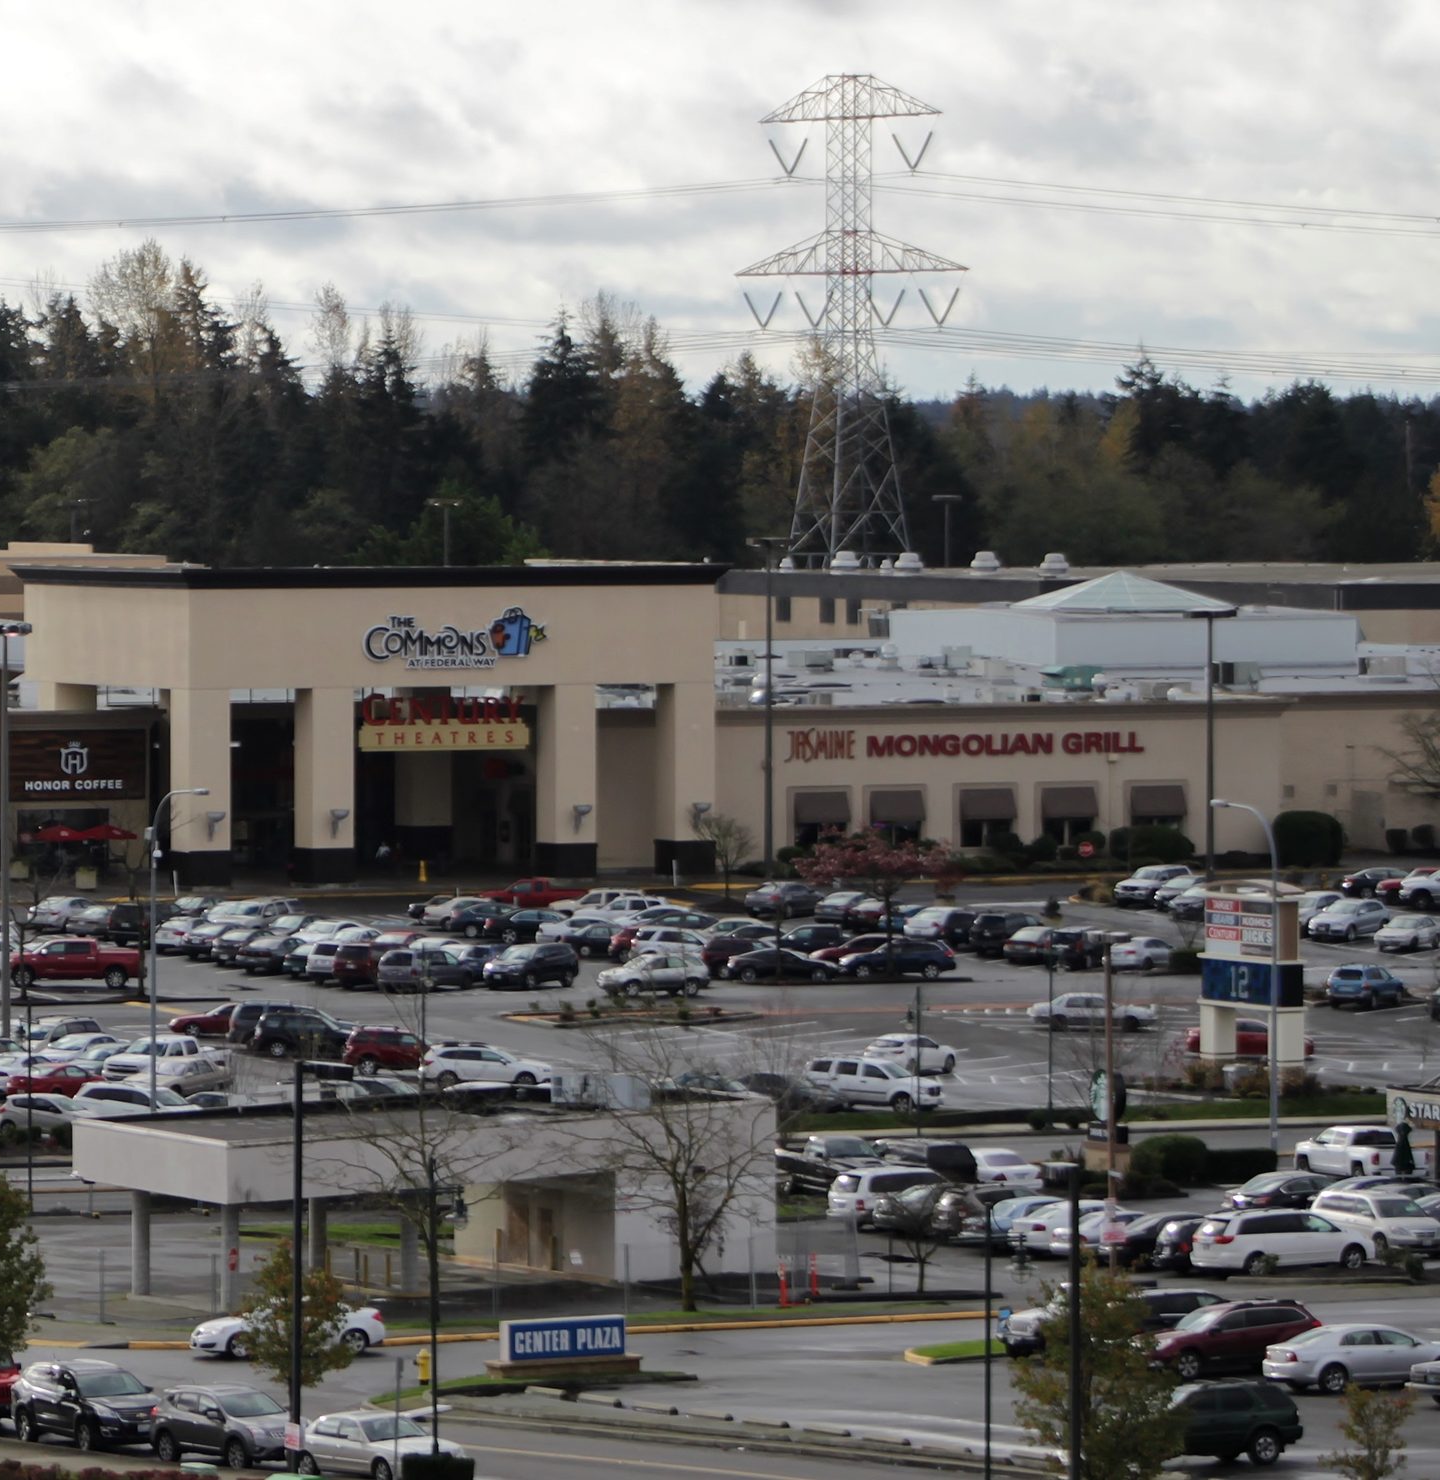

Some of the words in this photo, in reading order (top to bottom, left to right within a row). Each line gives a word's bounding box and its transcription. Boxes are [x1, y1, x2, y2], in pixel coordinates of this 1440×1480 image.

[390, 616, 415, 628] THE
[366, 626, 487, 660] COMMONS
[408, 659, 422, 667] AT
[424, 658, 471, 667] FEDERAL
[473, 658, 496, 667] WAY
[362, 693, 526, 726] CENTURY
[376, 730, 514, 745] THEATRES
[784, 728, 855, 763] JASMINE
[866, 733, 1053, 758] MONGOLIAN
[1061, 731, 1145, 755] GRILL
[24, 781, 70, 791] HONOR
[75, 780, 123, 790] COFFEE
[1208, 927, 1237, 939] CENTURY
[1230, 965, 1249, 999] 12
[514, 1329, 569, 1354] CENTER
[576, 1326, 621, 1351] PLAZA
